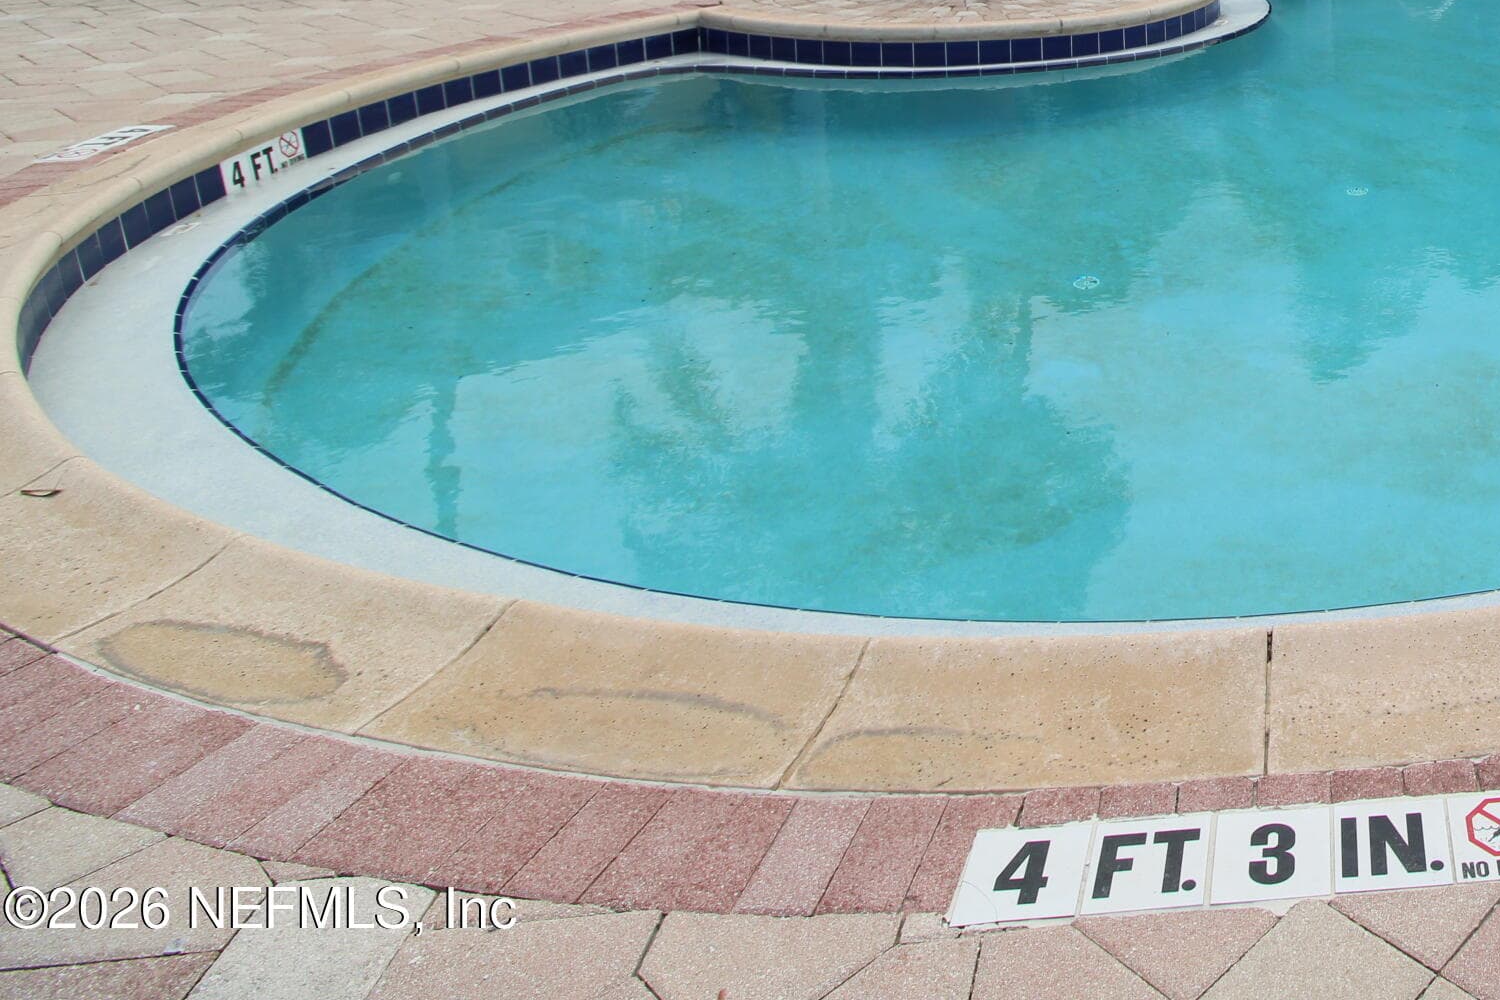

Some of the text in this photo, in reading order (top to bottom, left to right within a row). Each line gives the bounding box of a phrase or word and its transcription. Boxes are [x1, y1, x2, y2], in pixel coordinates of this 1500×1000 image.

[232, 146, 279, 188] 4 FT.
[993, 812, 1445, 905] 4 FT. 3 IN.
[1461, 860, 1490, 879] NO
